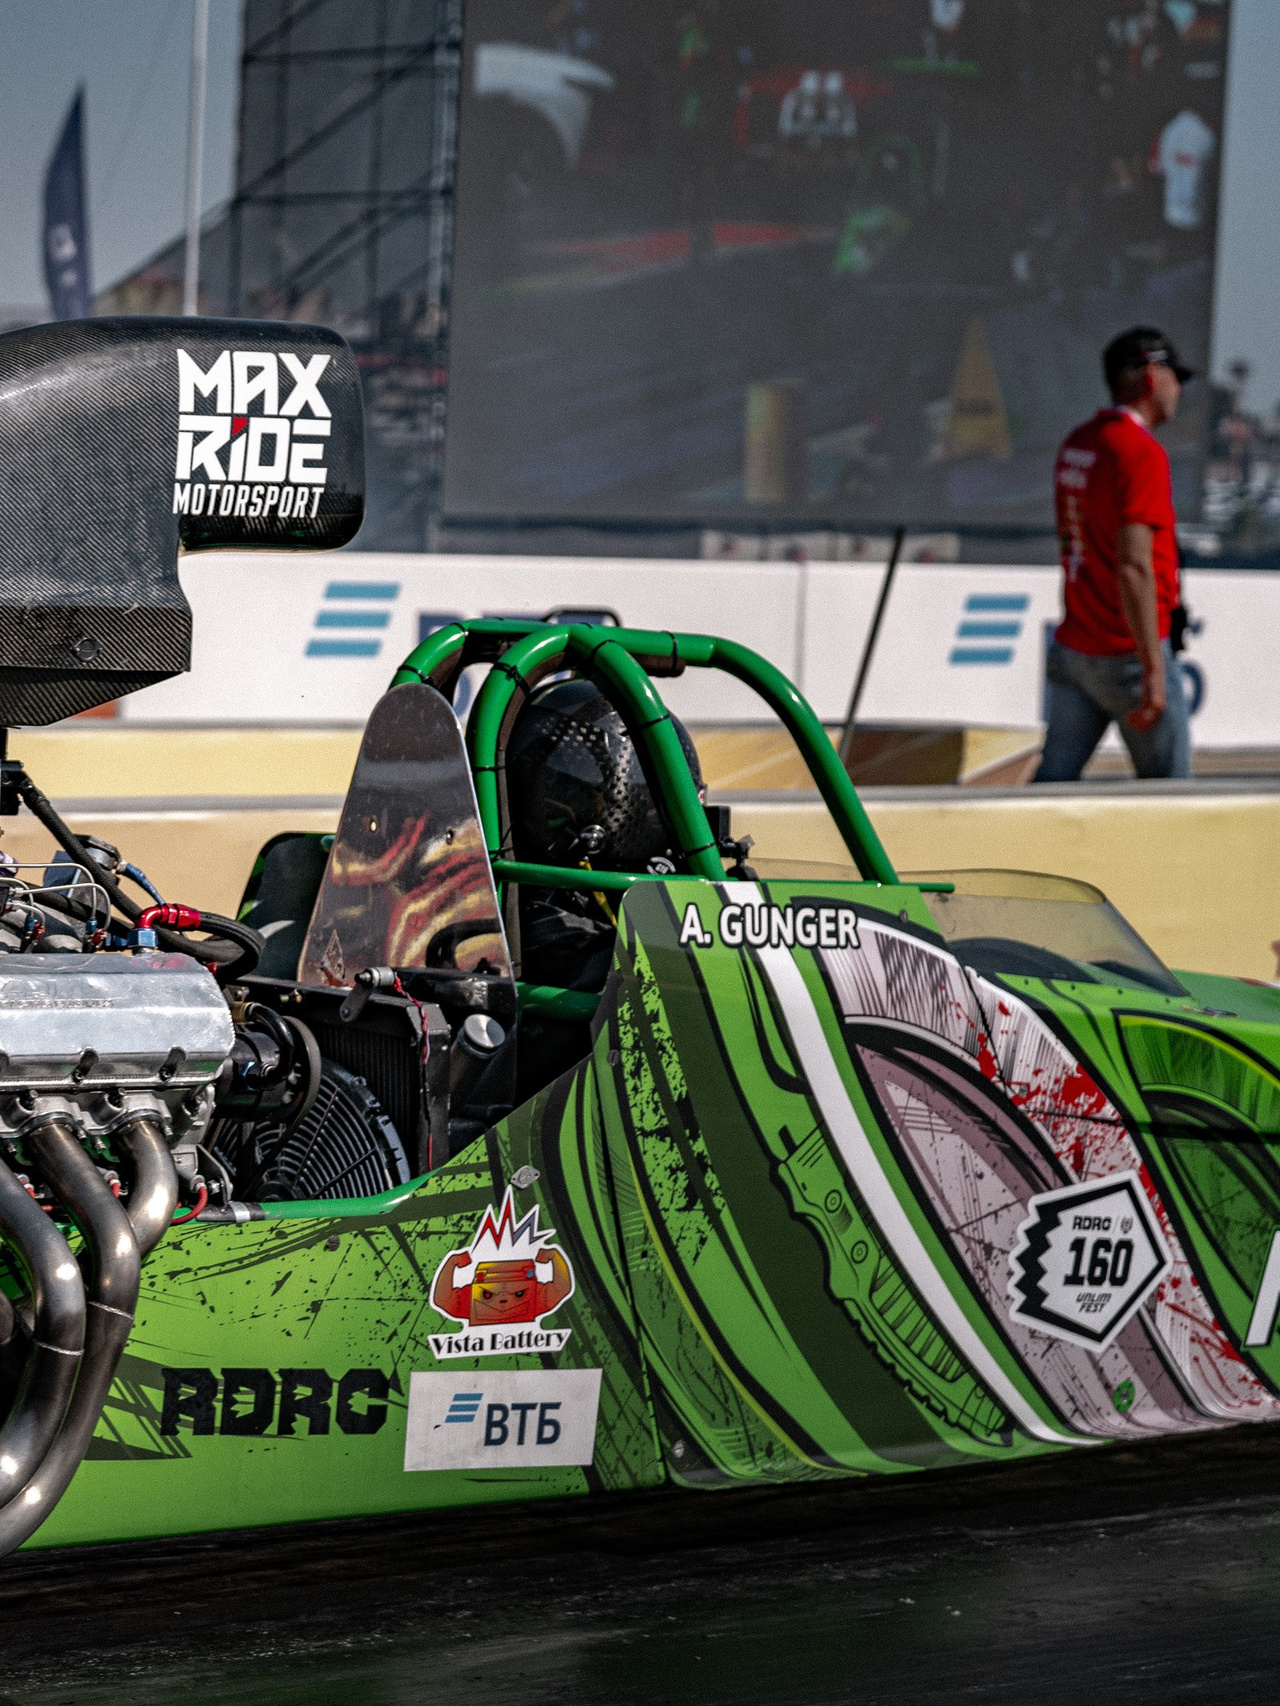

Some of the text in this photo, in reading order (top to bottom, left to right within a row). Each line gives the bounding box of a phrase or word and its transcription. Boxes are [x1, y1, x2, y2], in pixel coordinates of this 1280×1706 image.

[177, 348, 332, 418] MAX
[172, 482, 325, 519] MOTORSPORT
[679, 903, 860, 948] A. GUNGER
[1062, 1237, 1134, 1287] 160
[1079, 1302, 1107, 1312] FEST
[432, 1330, 568, 1355] Vista Battery
[160, 1367, 390, 1436] RDRC
[483, 1402, 563, 1446] ВТБ
